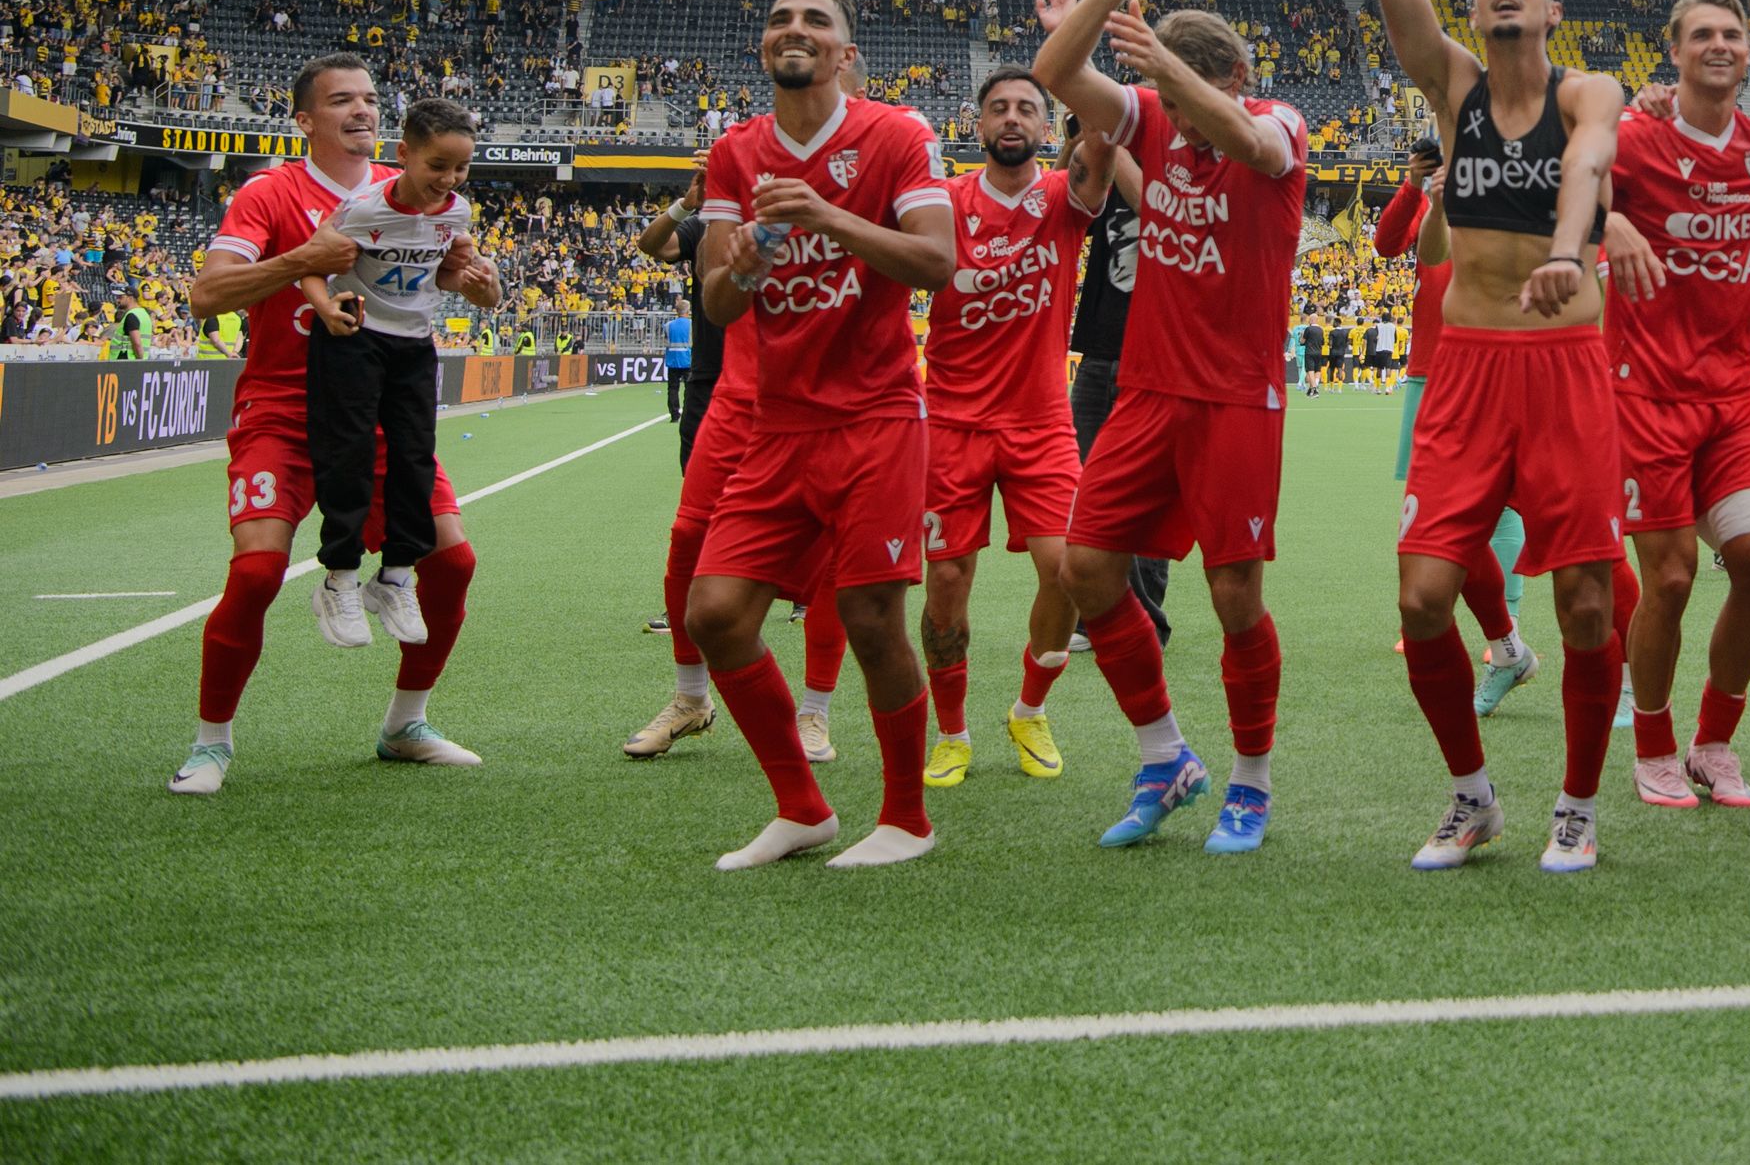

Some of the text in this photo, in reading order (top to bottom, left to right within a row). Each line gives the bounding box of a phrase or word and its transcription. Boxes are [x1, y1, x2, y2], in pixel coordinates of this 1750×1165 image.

[598, 74, 624, 90] D3
[162, 128, 245, 153] STADION
[485, 147, 561, 164] CSL Behring
[1456, 157, 1562, 198] gpexe
[773, 233, 853, 266] OIKE
[598, 362, 616, 377] vs
[622, 357, 647, 383] FC
[96, 361, 209, 446] YB vs FC ZÜRICH
[230, 471, 278, 517] 33
